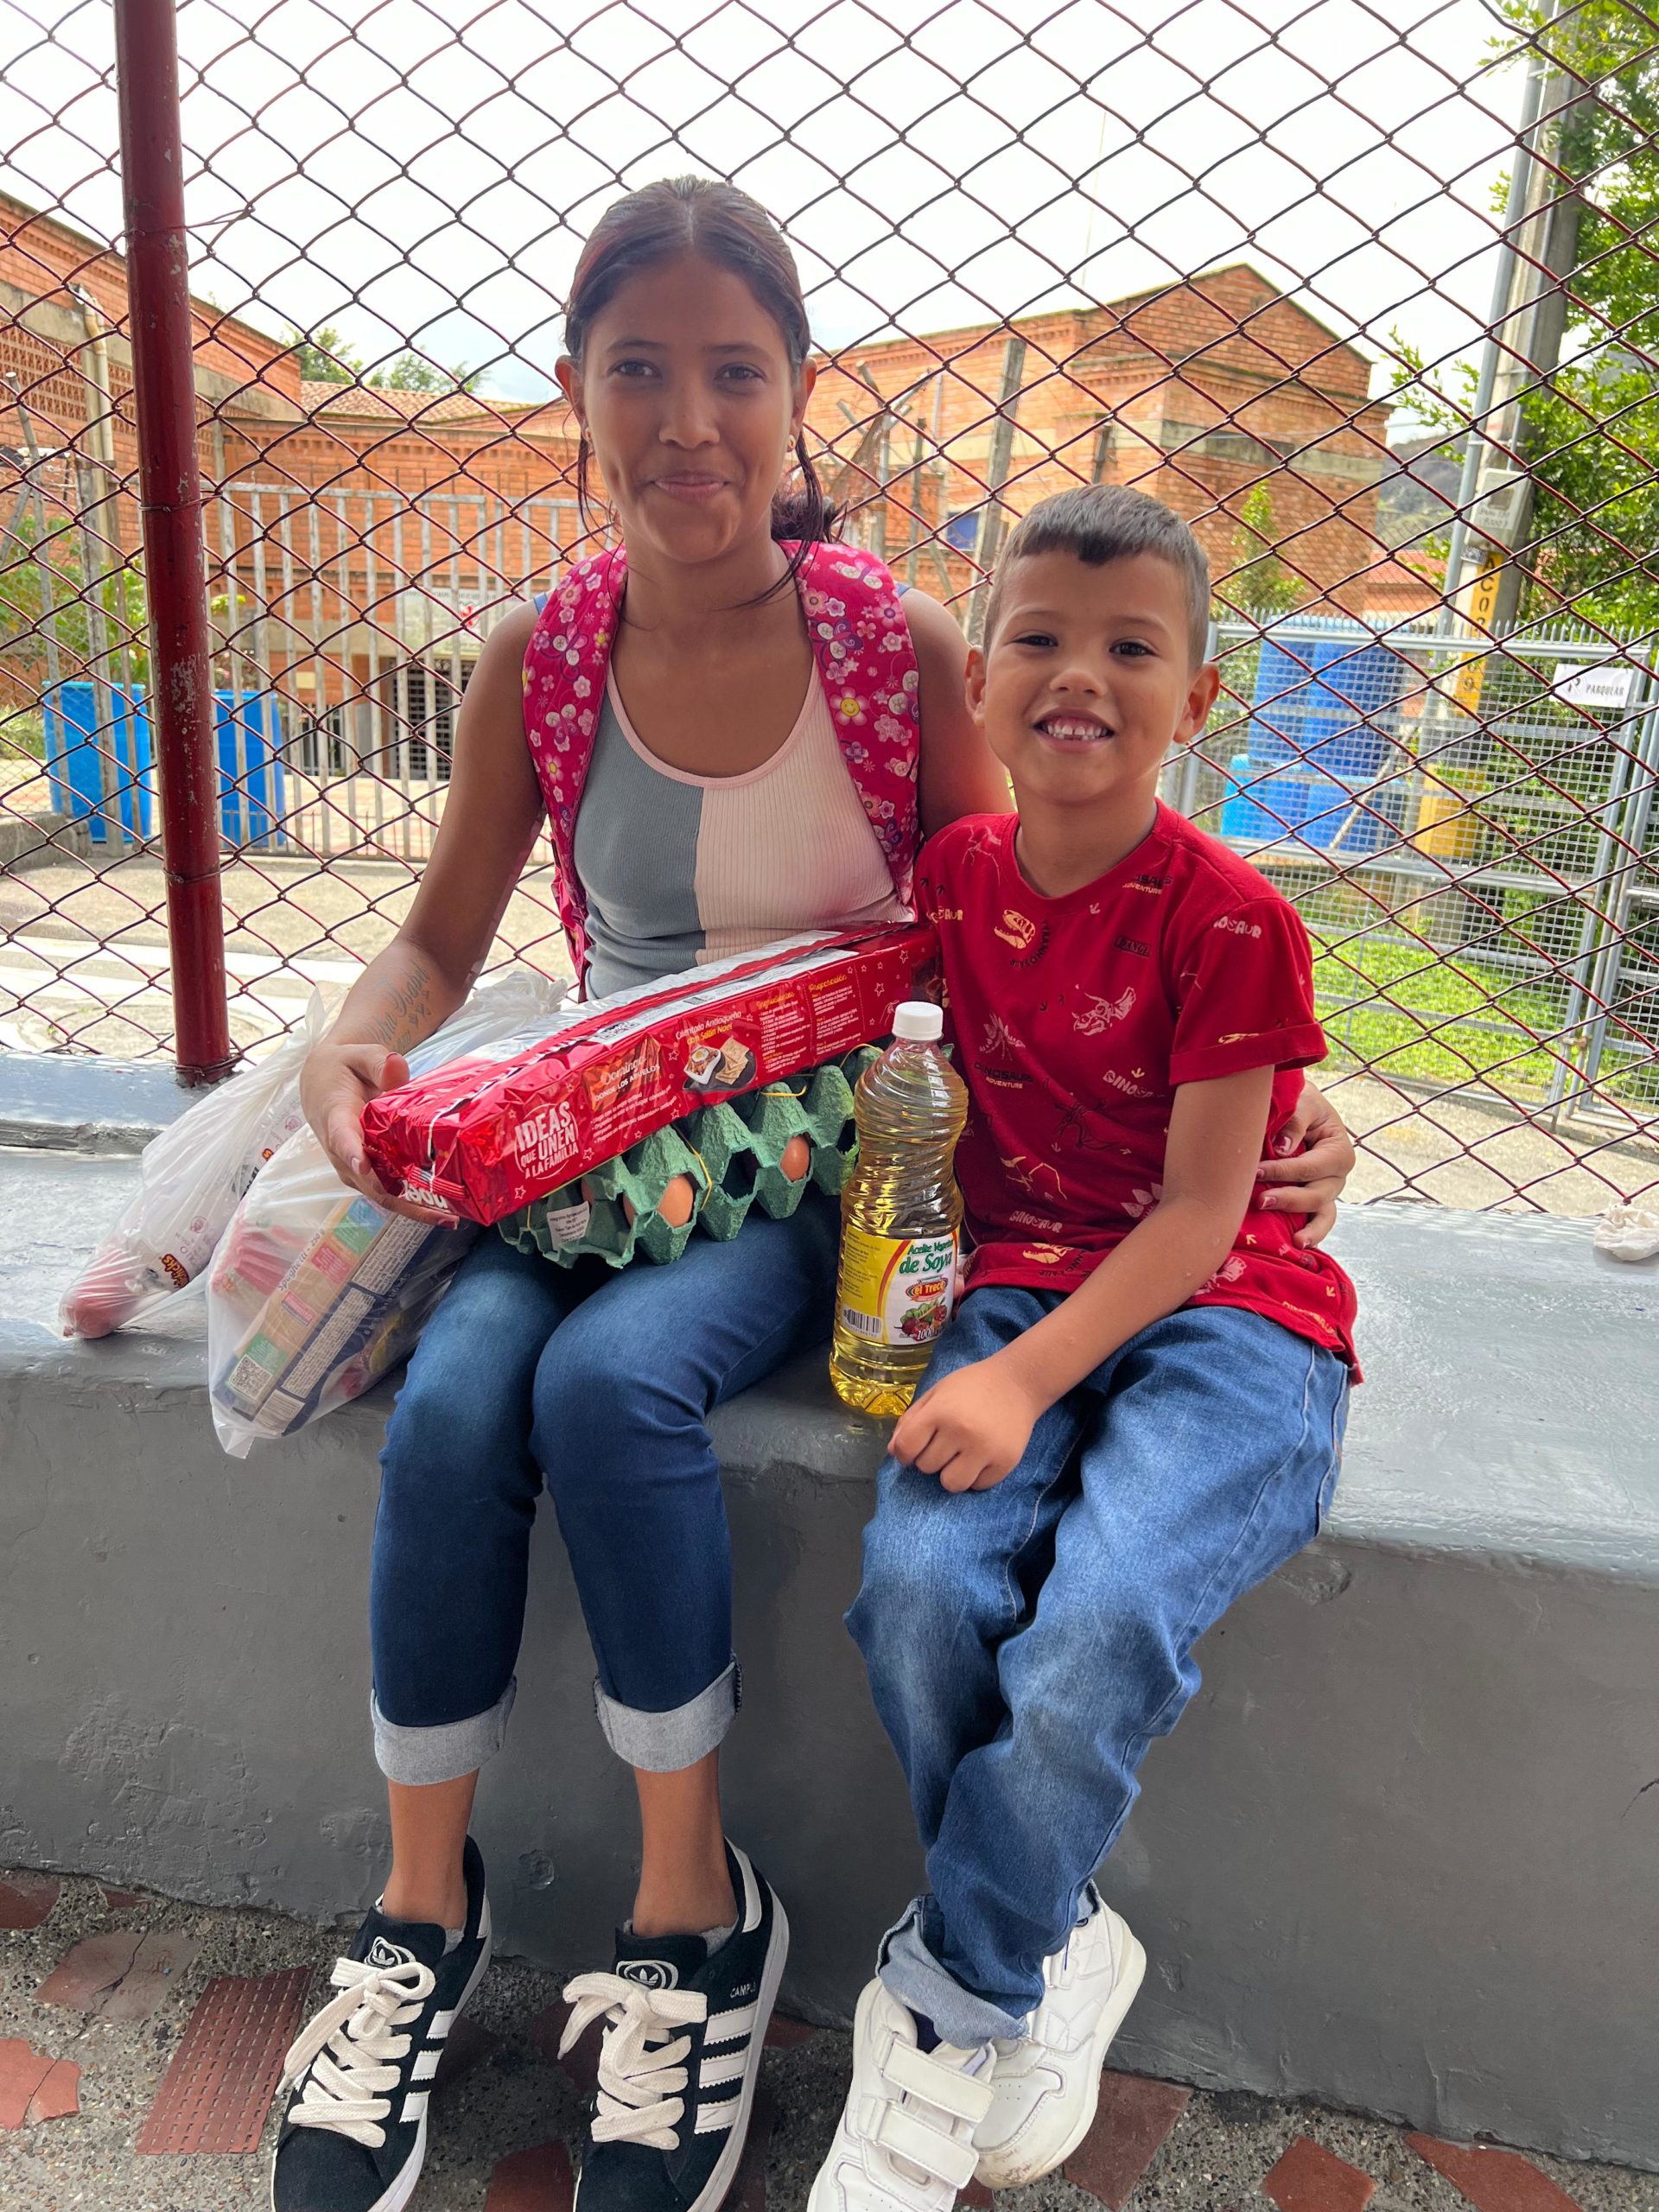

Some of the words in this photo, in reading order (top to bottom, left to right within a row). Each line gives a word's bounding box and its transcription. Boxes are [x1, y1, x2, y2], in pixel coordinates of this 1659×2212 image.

[705, 1011, 741, 1028] Antioqueño
[594, 1086, 618, 1102] DONDE
[618, 1078, 629, 1091] LOS
[630, 1064, 661, 1082] ABUELOS
[986, 1077, 1023, 1089] ADVENTURE
[515, 1102, 572, 1153] IDEAS
[520, 1149, 536, 1167] QUE
[537, 1124, 575, 1160] UNEN
[525, 1168, 531, 1179] A
[532, 1161, 543, 1177] LA
[544, 1142, 579, 1169] FAMILIA
[899, 1256, 920, 1274] de
[922, 1251, 953, 1273] Soya
[907, 1243, 932, 1255] Aceite
[277, 1251, 308, 1291] Spaghetti
[914, 1286, 923, 1295] el
[925, 1280, 944, 1294] Trece
